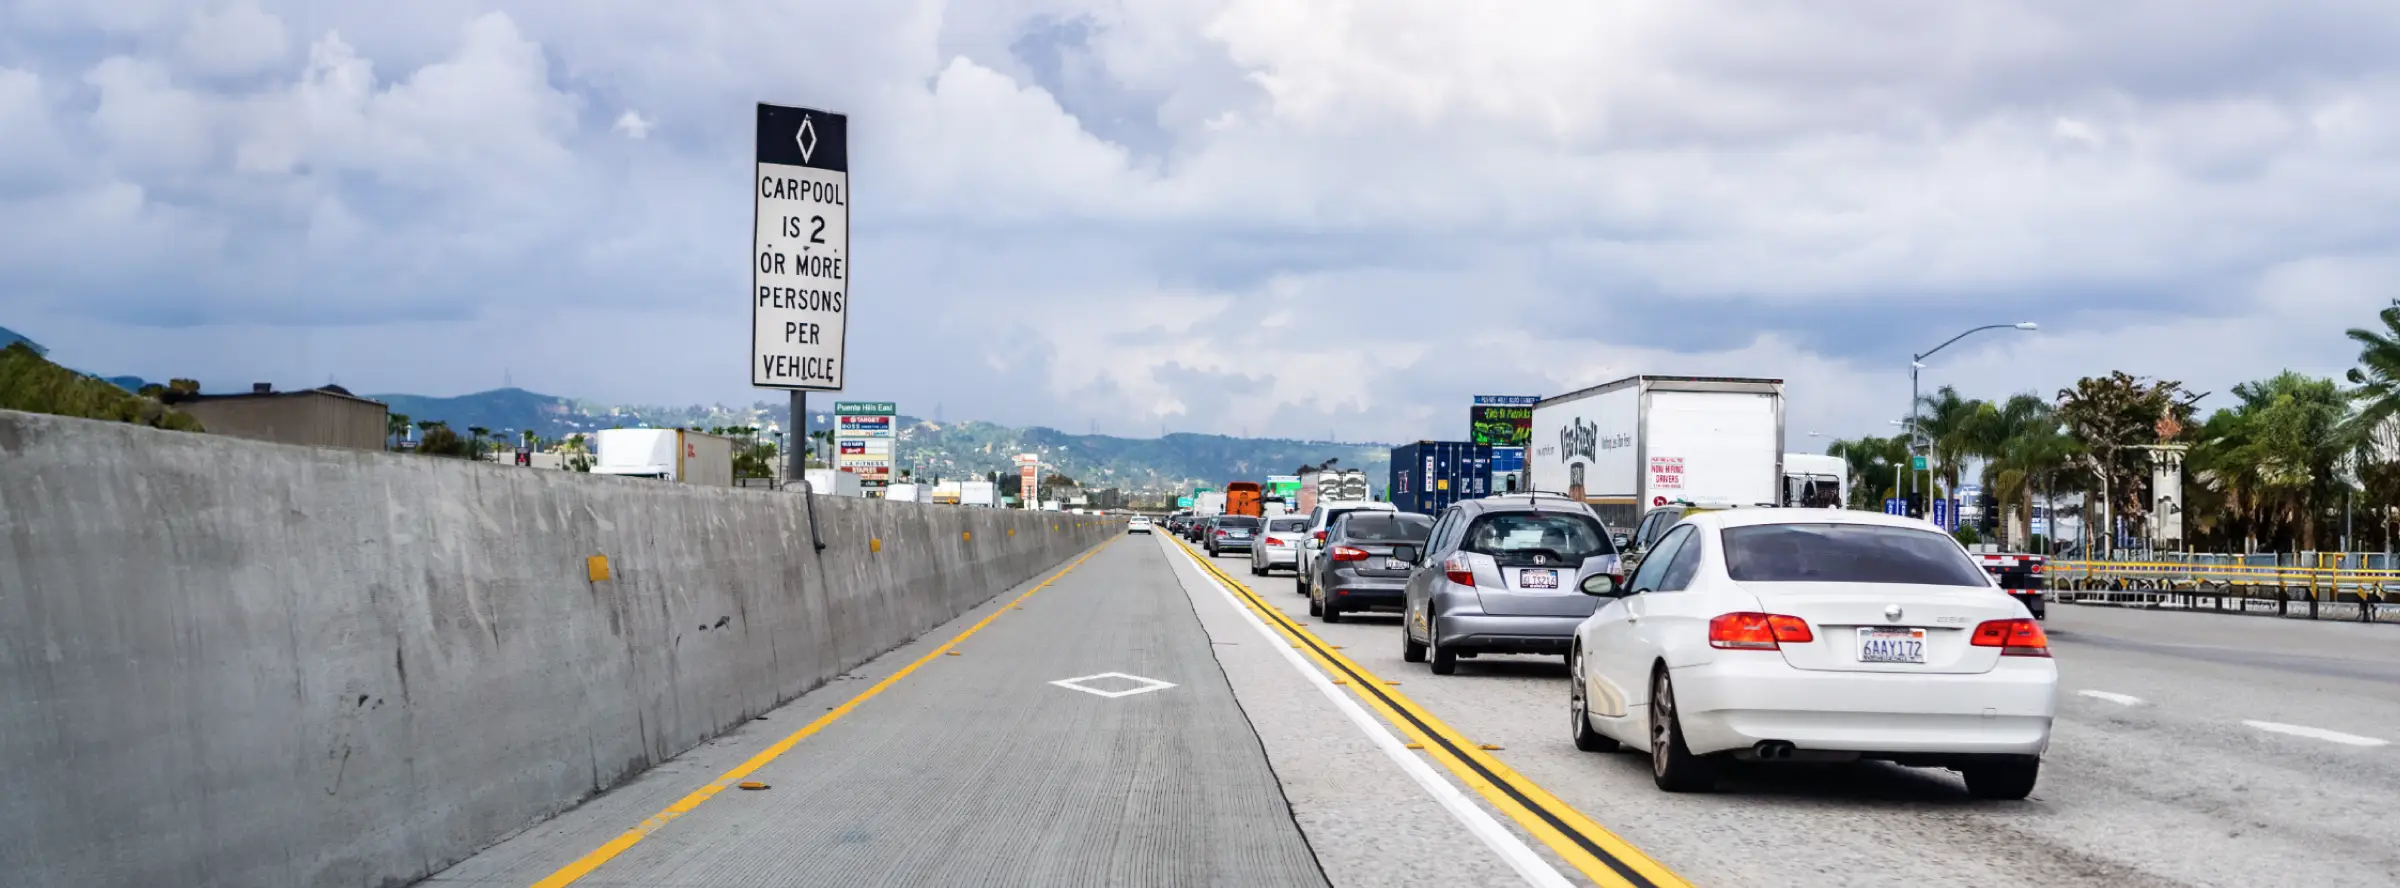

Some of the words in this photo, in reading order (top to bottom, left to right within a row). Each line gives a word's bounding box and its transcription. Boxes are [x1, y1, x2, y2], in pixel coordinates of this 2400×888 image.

[761, 175, 844, 206] CARPOOL
[783, 216, 801, 238] IS
[810, 215, 825, 244] 2
[760, 252, 786, 275] OR
[796, 254, 842, 279] MORE
[760, 286, 842, 313] PERSONS
[785, 321, 820, 345] PER
[763, 354, 834, 381] VEHICLE
[862, 403, 877, 411] Hills
[878, 403, 893, 412] East
[1652, 464, 1664, 474] NOW
[1666, 464, 1684, 474] HIRING
[1656, 474, 1680, 484] DRIVERS
[1864, 640, 1922, 657] 6AAY172
